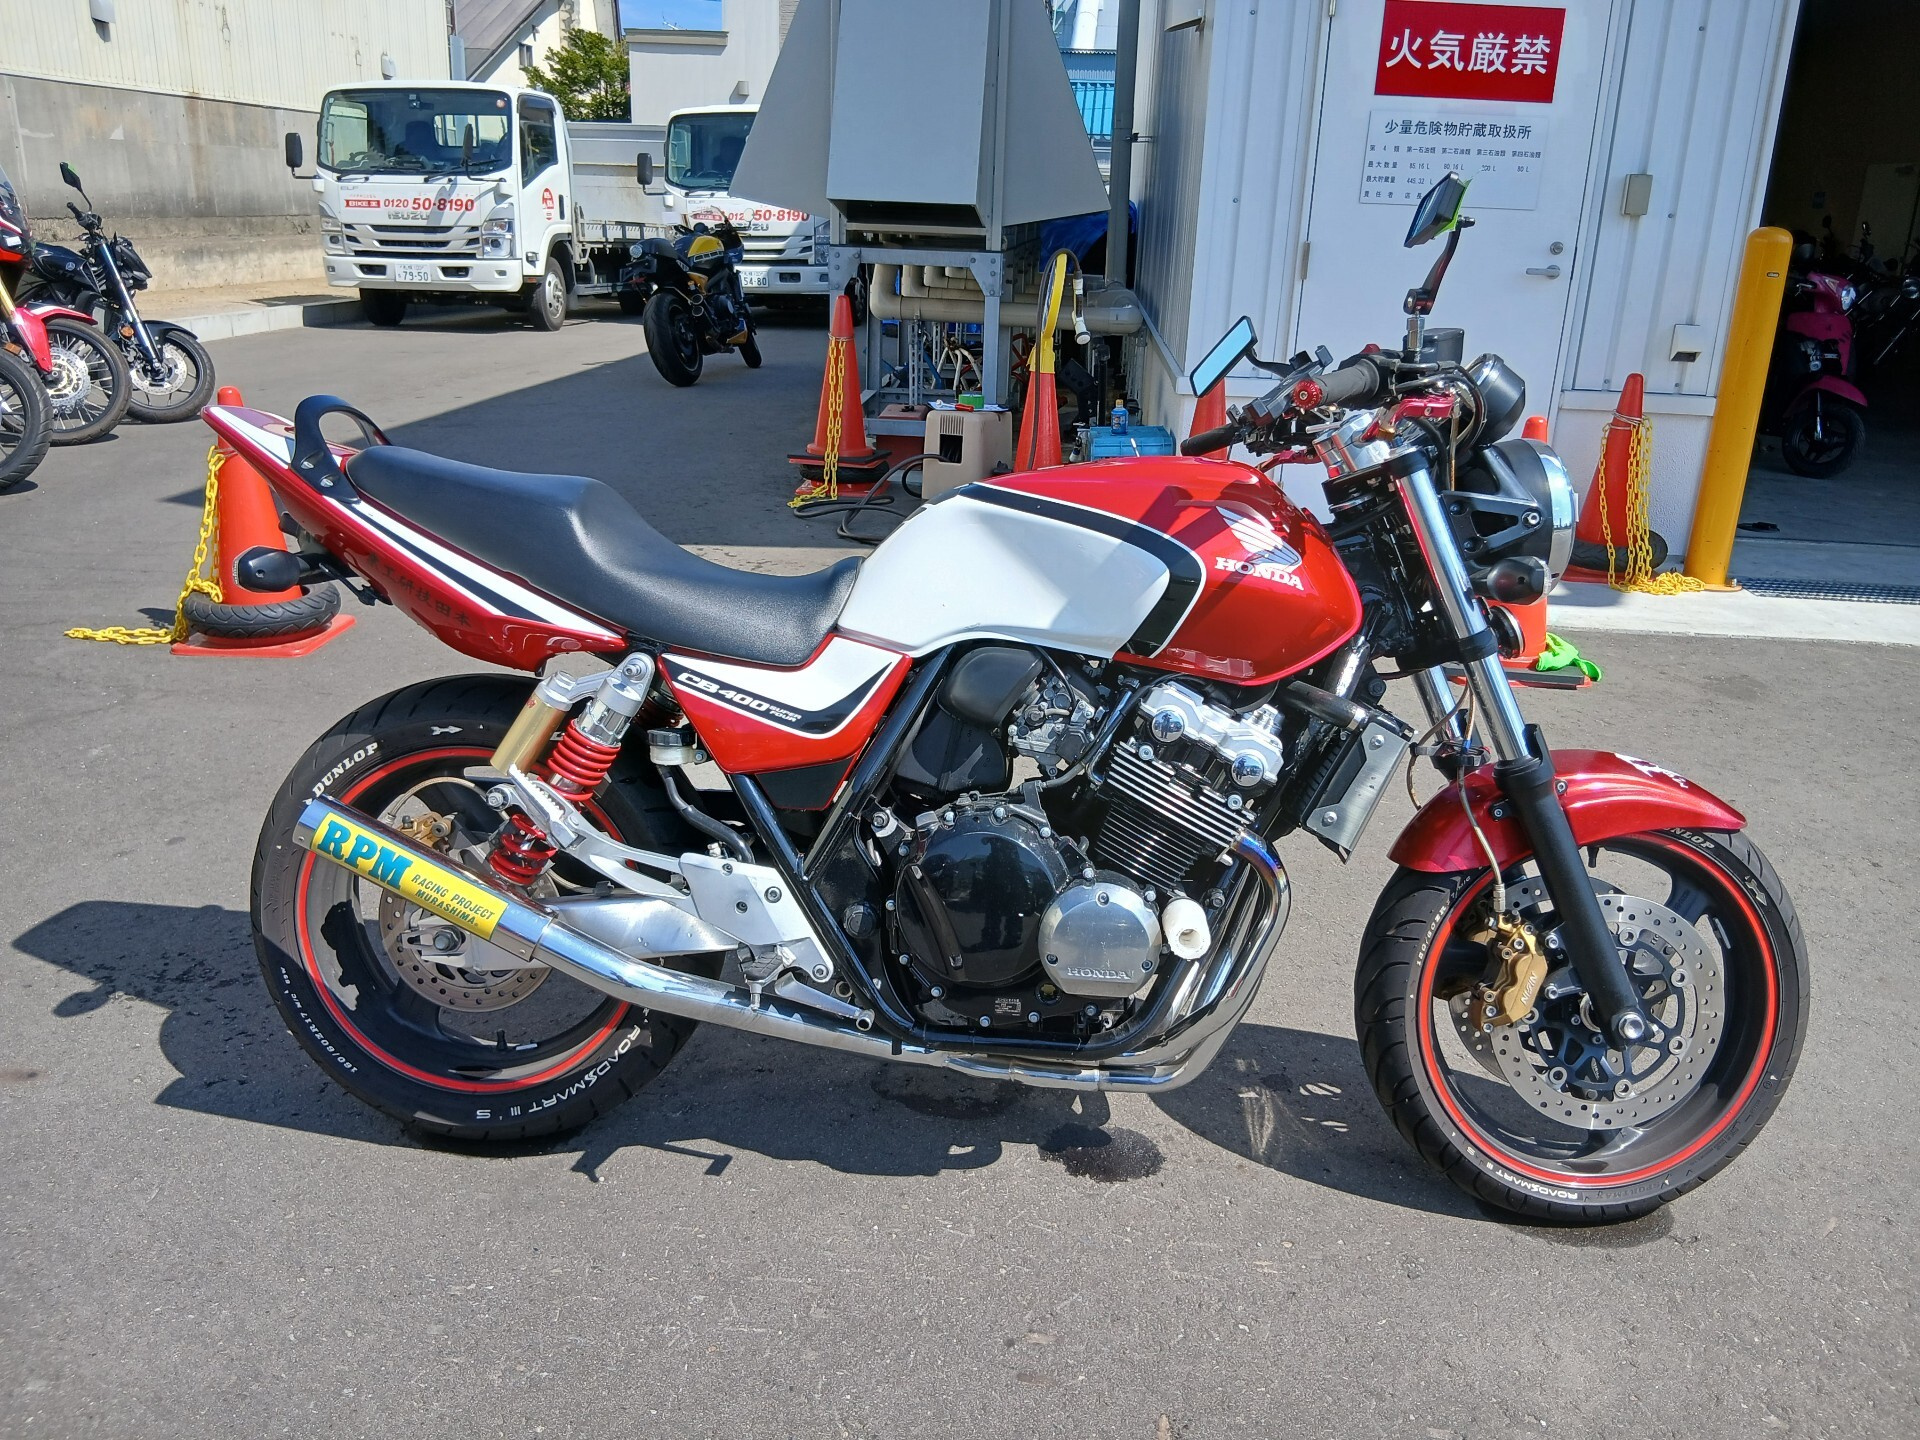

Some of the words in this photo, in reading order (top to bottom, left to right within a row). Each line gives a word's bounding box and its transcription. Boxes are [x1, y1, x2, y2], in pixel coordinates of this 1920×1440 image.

[1385, 28, 1551, 75] 火気厳禁
[1384, 119, 1532, 140] 少量危険物貯蔵取扱所
[383, 198, 409, 208] 0120
[728, 212, 745, 221] 012
[743, 276, 767, 286] 54-80
[1214, 556, 1304, 591] HONDA
[769, 705, 802, 720] SUPER
[769, 711, 798, 722] FOUR
[311, 741, 378, 798] DUNLOP
[317, 820, 414, 890] RPM
[411, 873, 450, 898] RACING
[451, 887, 496, 921] PROJECT
[1066, 967, 1131, 981] HONDA
[529, 1024, 641, 1113] ROADSMART
[1495, 1169, 1578, 1200] ROADSMART
